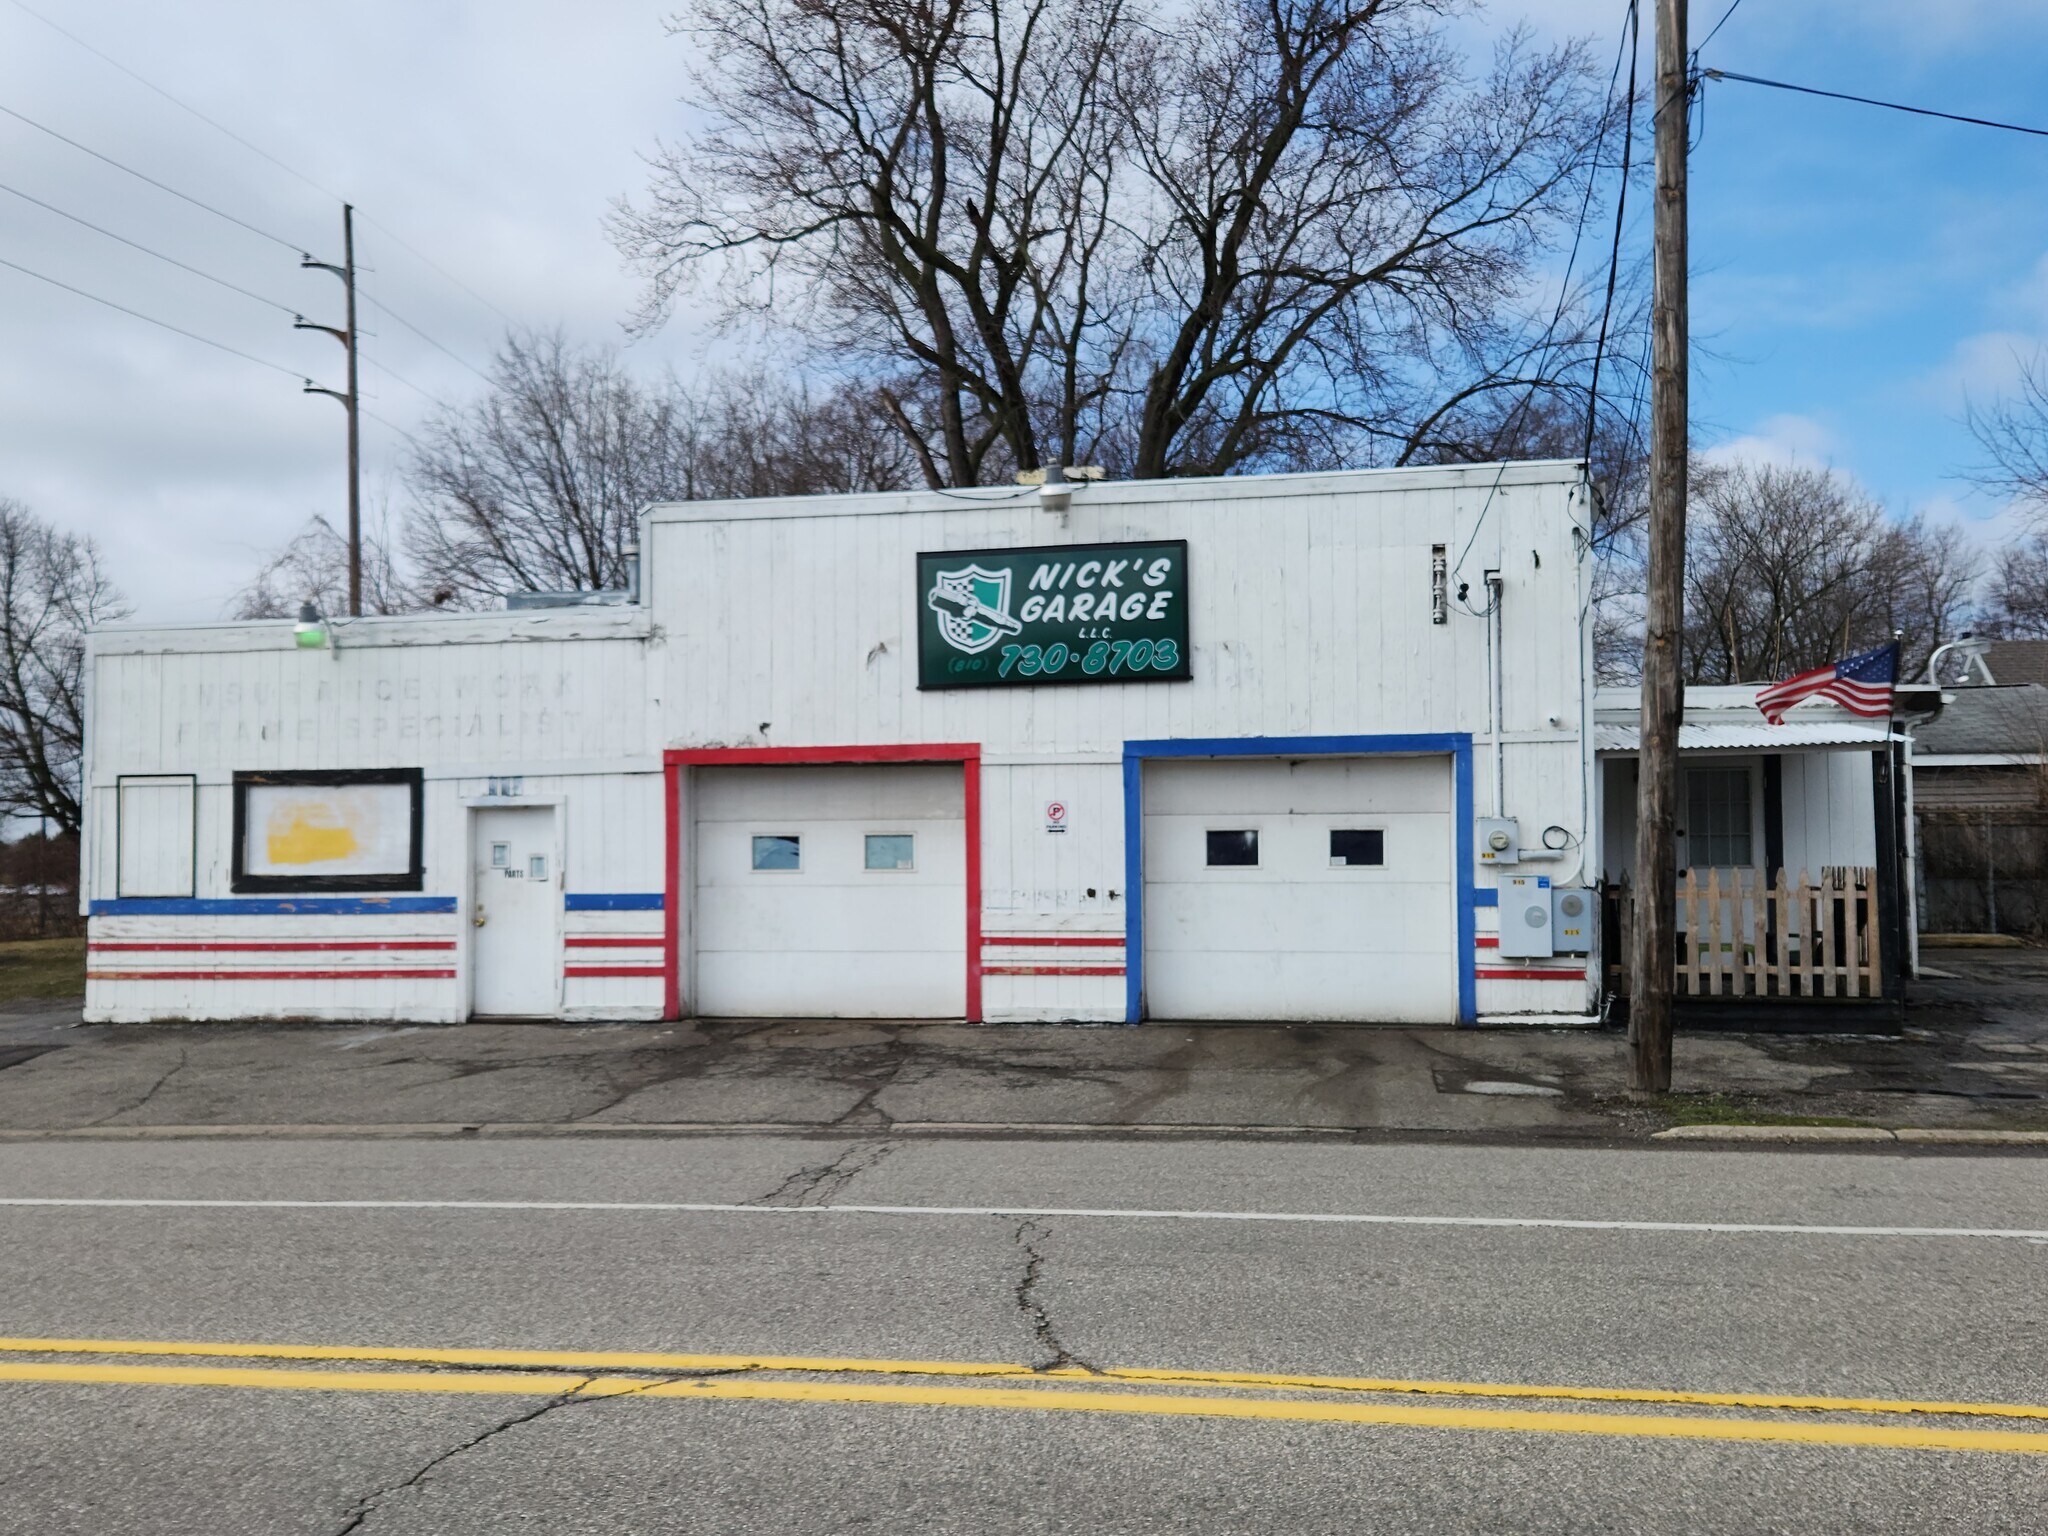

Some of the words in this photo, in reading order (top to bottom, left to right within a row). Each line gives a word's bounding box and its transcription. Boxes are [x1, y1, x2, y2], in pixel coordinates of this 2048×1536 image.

[1028, 557, 1172, 591] NICK'S
[1019, 591, 1173, 623] GARAGE
[1078, 627, 1112, 639] L.L.C.
[504, 869, 524, 878] PARTS
